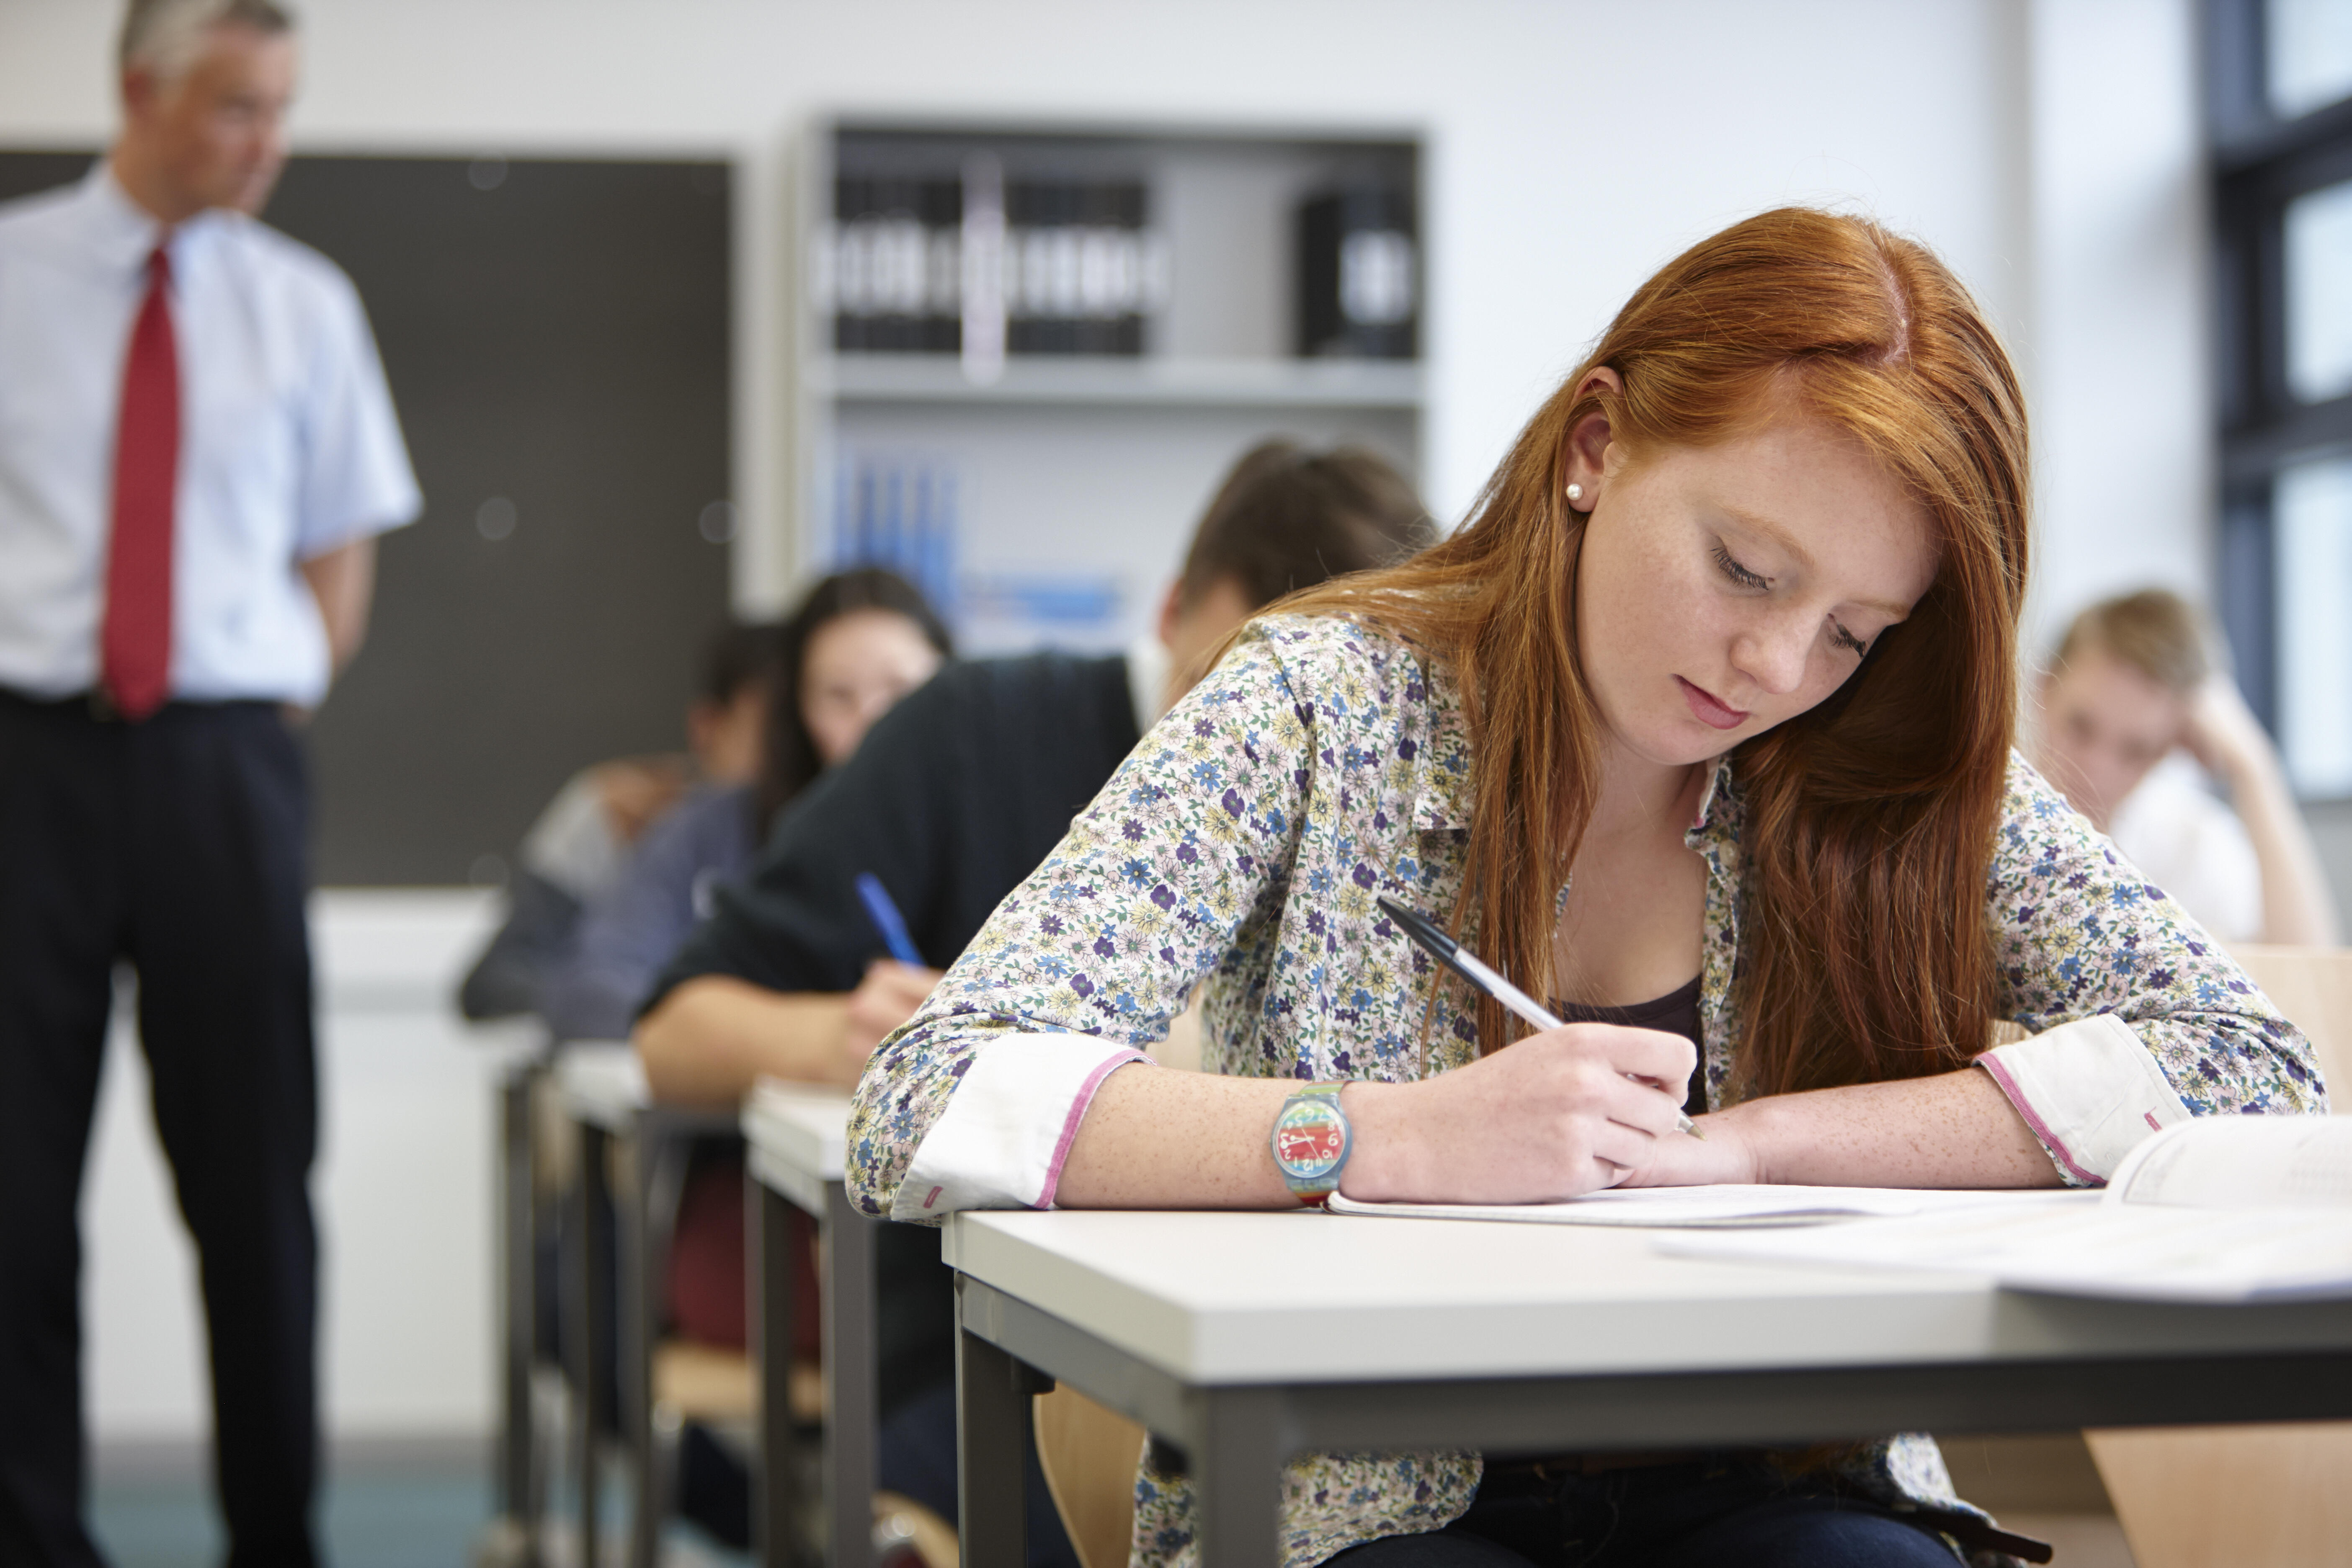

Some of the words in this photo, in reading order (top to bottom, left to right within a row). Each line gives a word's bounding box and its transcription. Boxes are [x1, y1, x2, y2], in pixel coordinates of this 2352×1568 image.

[1295, 1114, 1303, 1126] 5
[1305, 1108, 1314, 1122] 6
[1318, 1112, 1326, 1122] 7
[1328, 1121, 1335, 1131] 8
[1328, 1133, 1338, 1146] 9
[1284, 1149, 1291, 1159] 2
[1322, 1150, 1333, 1159] 10
[1302, 1159, 1314, 1171] 12
